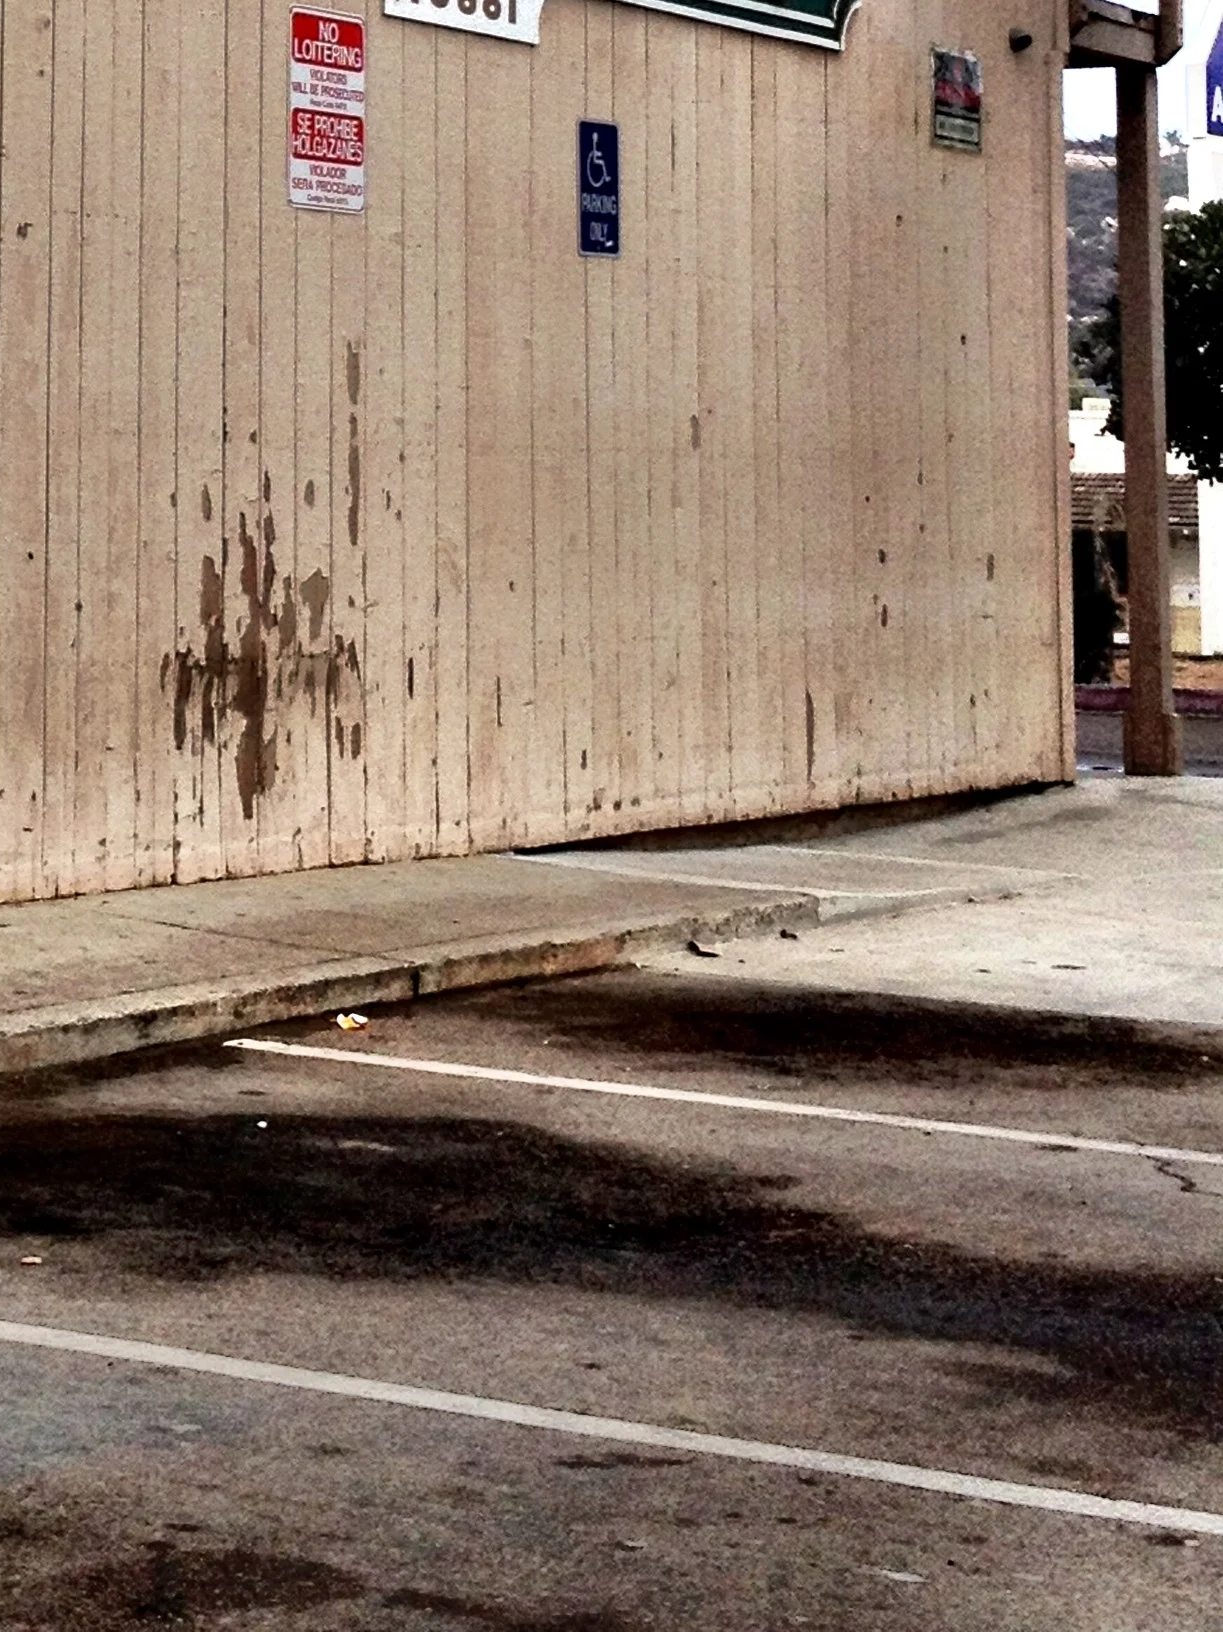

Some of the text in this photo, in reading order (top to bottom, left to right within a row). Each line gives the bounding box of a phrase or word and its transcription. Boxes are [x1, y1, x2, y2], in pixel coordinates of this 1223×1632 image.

[318, 20, 340, 42] NO
[294, 37, 362, 68] LOITERING
[297, 112, 313, 134] SE
[292, 133, 363, 162] HOLGAZANES
[581, 192, 617, 215] PARKING
